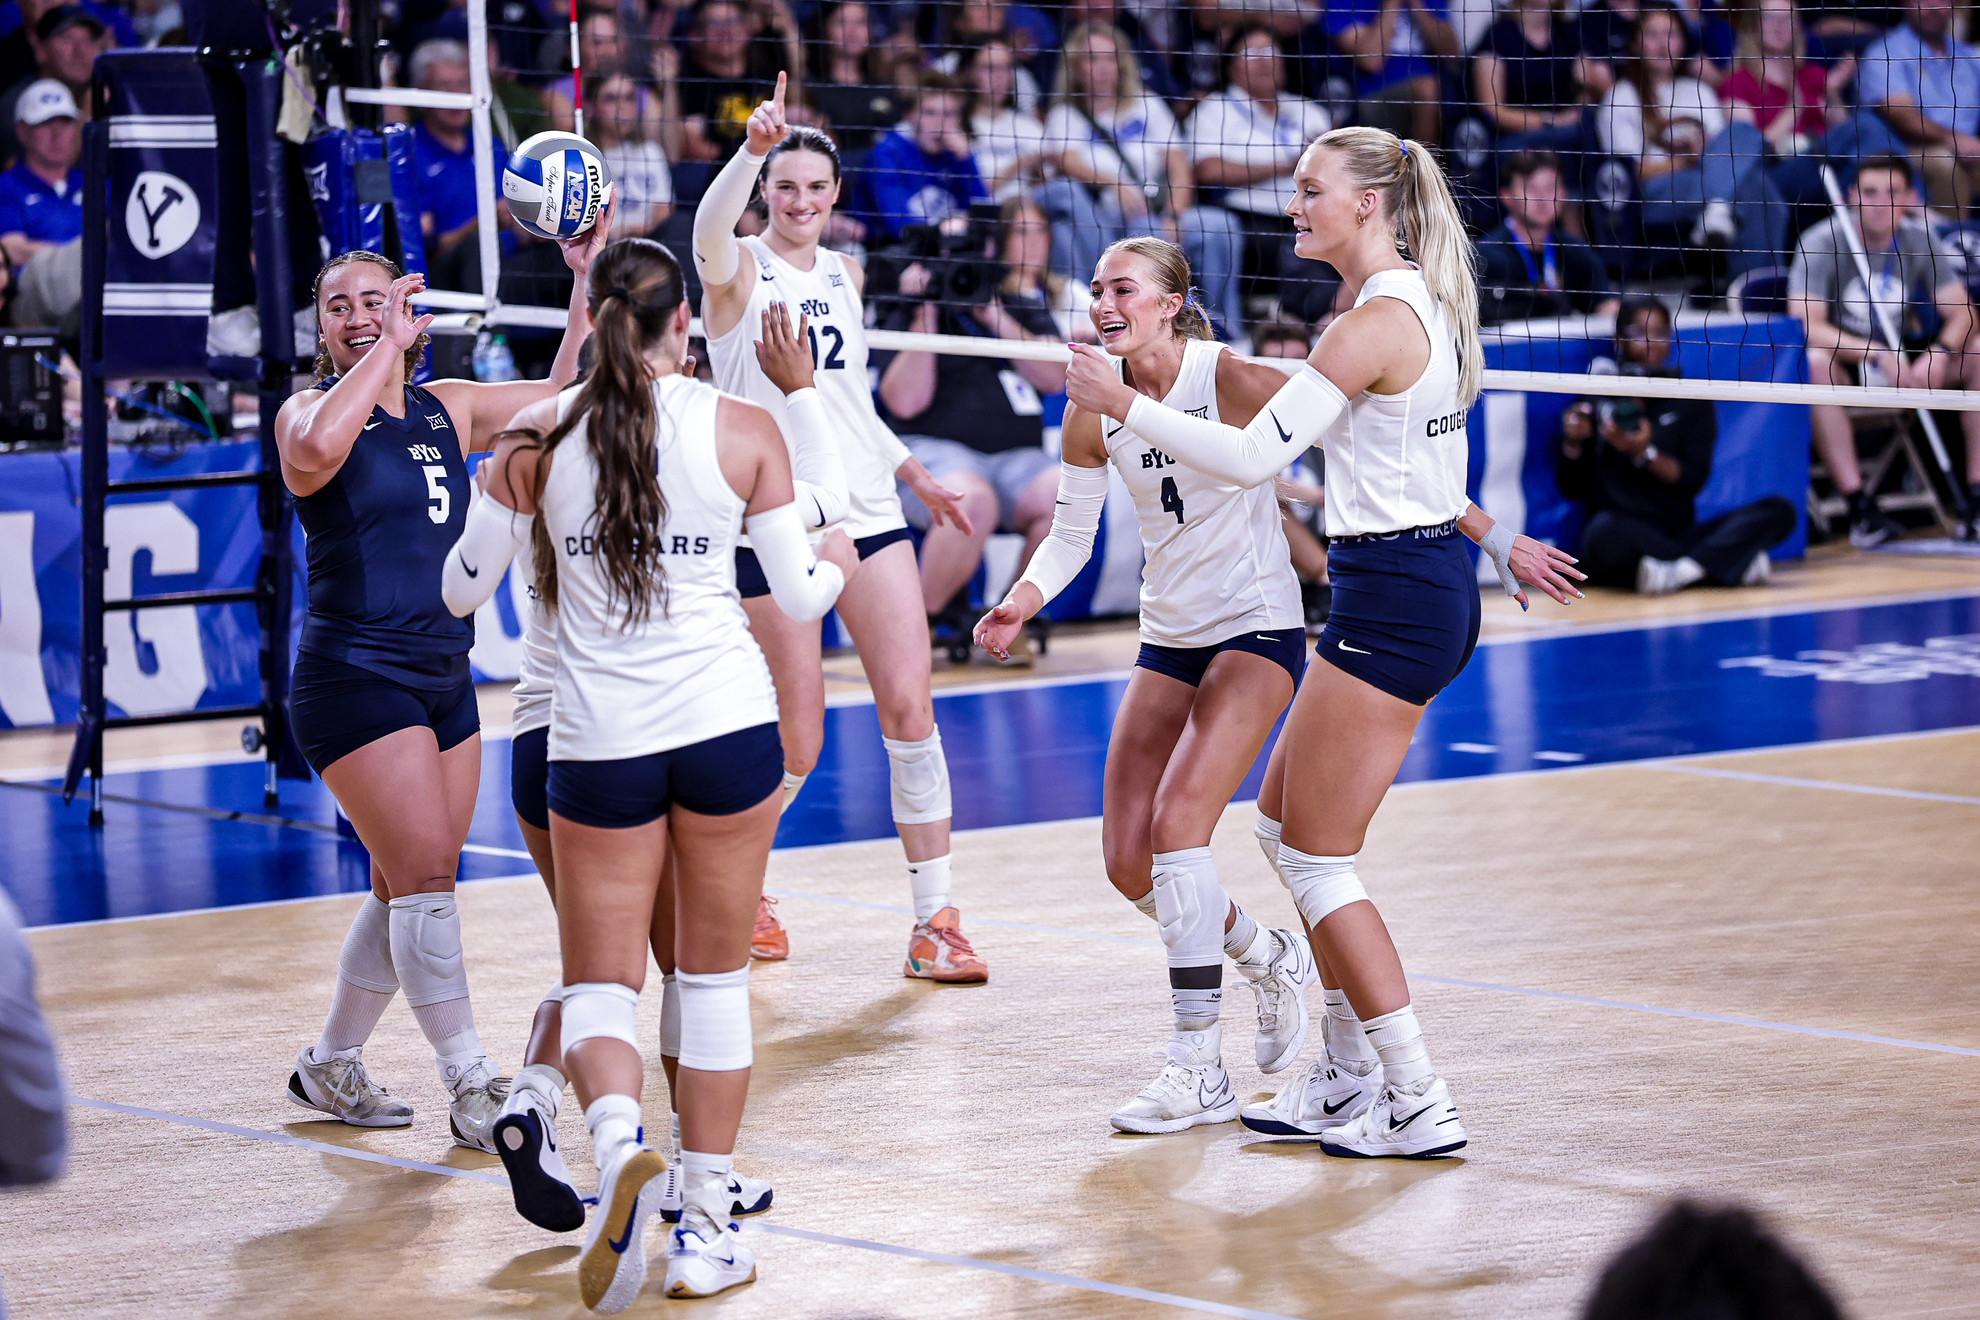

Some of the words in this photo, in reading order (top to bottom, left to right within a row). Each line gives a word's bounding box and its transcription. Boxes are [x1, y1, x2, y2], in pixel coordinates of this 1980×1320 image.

[545, 165, 560, 194] Super
[566, 170, 585, 220] NCAA
[583, 165, 601, 224] molten
[137, 182, 184, 249] Y
[545, 196, 557, 223] Touch
[799, 299, 830, 317] BYU
[807, 325, 846, 371] 12
[1426, 407, 1468, 438] COUGA
[406, 444, 443, 462] BYU
[422, 465, 450, 524] 5
[1160, 476, 1185, 524] 4
[565, 535, 710, 556] COARS
